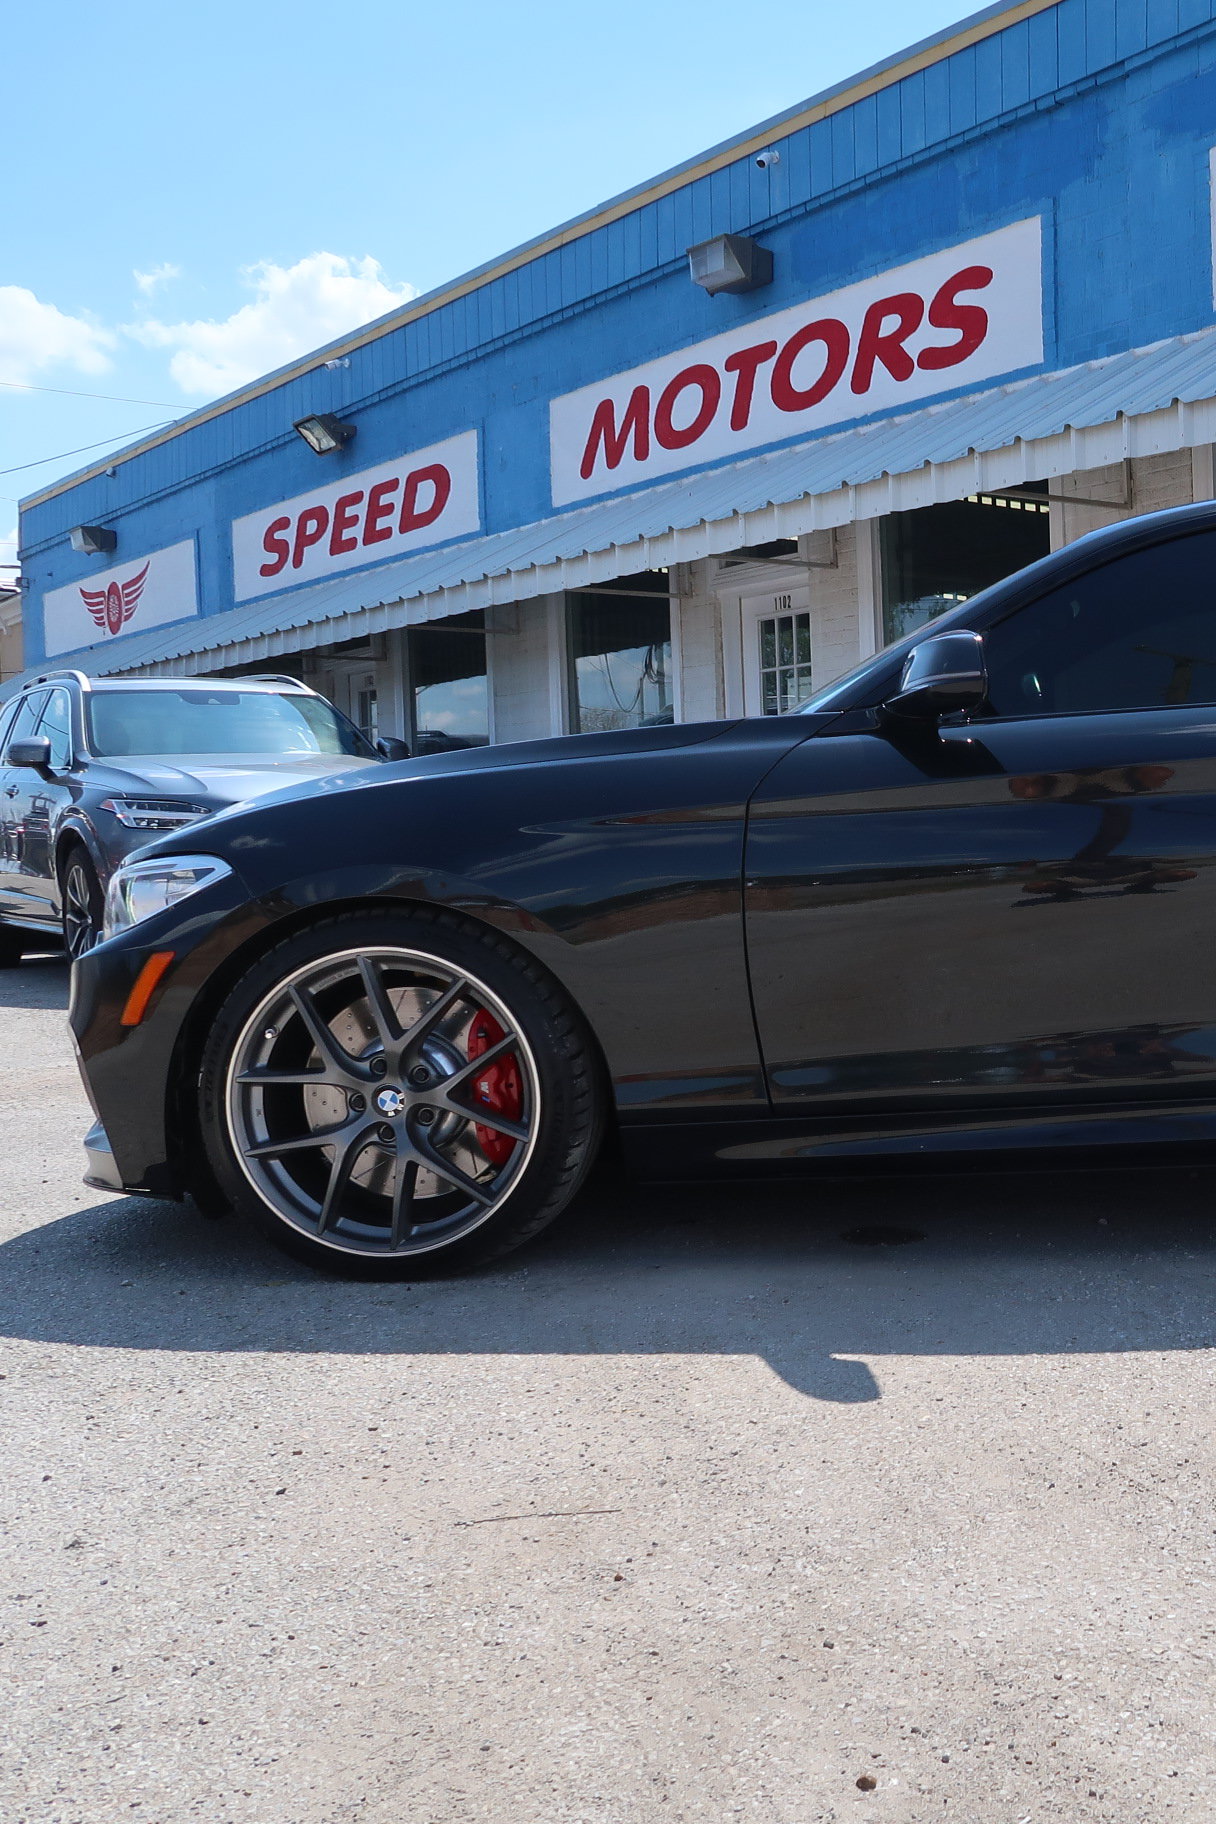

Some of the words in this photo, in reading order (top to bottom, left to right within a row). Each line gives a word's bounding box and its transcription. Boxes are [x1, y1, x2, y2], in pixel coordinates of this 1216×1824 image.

[580, 265, 993, 480] MOTORS
[259, 463, 451, 577] SPEED
[774, 595, 792, 611] 1102
